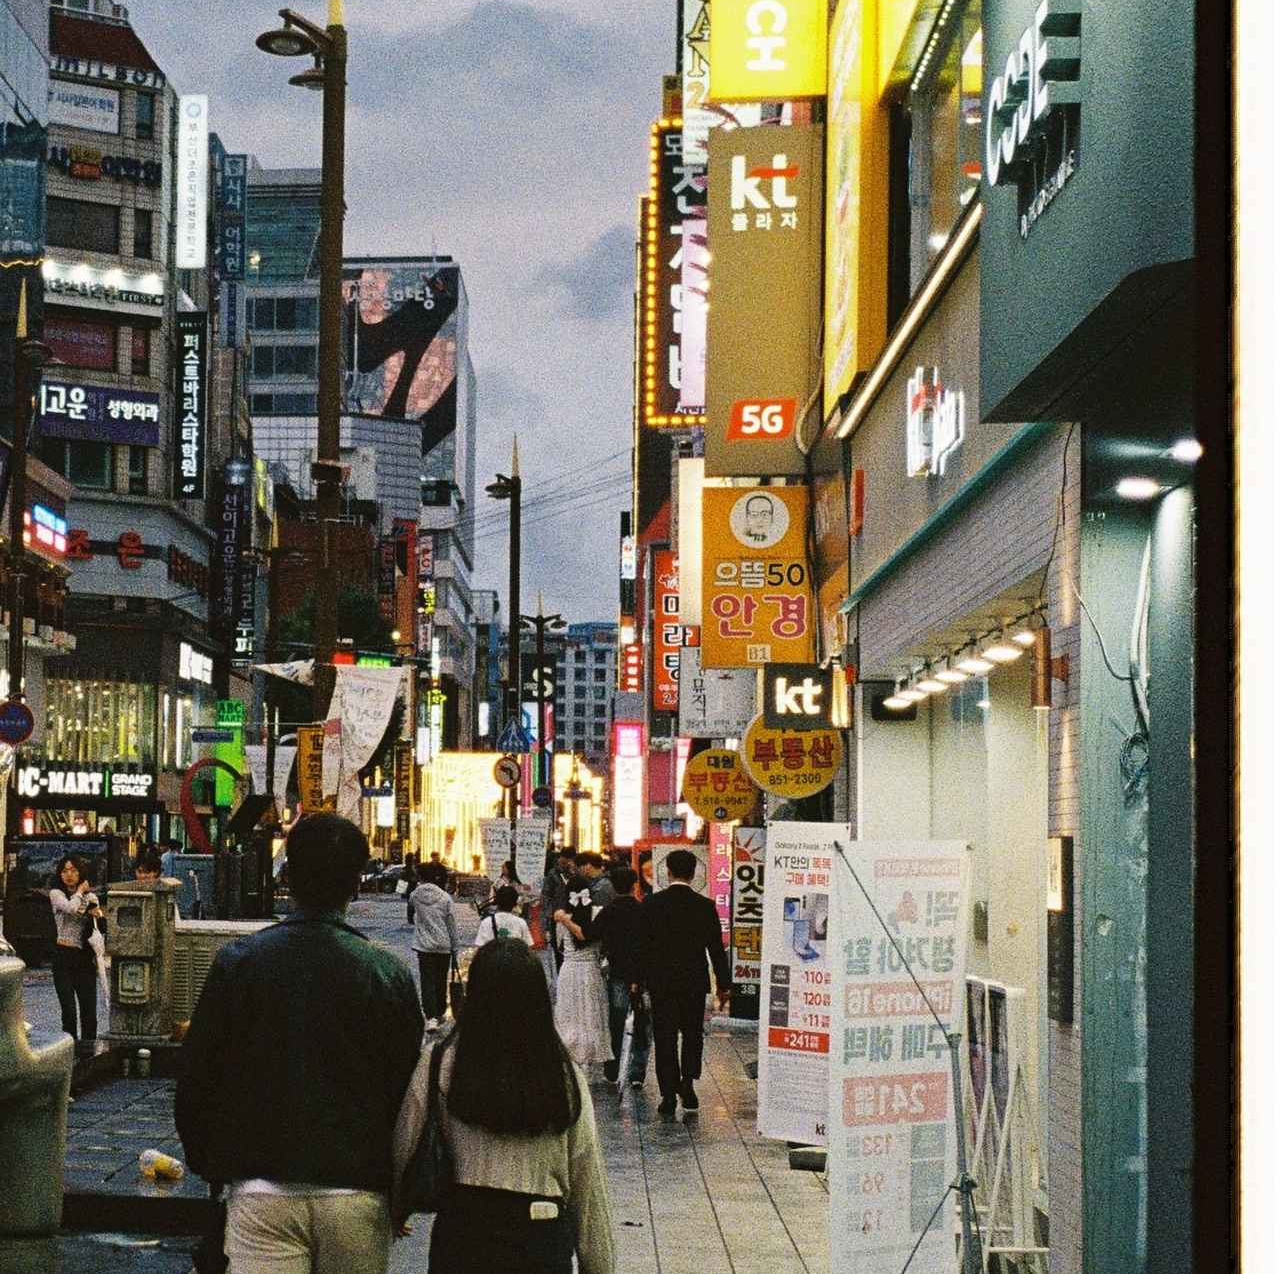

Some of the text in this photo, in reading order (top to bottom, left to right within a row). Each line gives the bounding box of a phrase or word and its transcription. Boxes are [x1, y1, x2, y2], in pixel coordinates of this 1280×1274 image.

[731, 154, 799, 210] kt
[731, 212, 798, 232] 플라자
[106, 398, 159, 423] 성형외과
[181, 333, 199, 478] 퍼스트바리스타학원
[740, 404, 784, 435] 5G
[182, 484, 195, 494] 4F
[714, 560, 803, 589] 으뜸50
[711, 593, 808, 639] 안경
[748, 644, 769, 662] B1
[775, 676, 823, 715] kt
[217, 703, 242, 714] ABC
[752, 739, 834, 770] 부동산
[111, 773, 152, 786] GRAND
[688, 772, 753, 794] 부동산
[769, 775, 821, 786] 851-2300
[111, 785, 148, 797] STAGE
[774, 855, 810, 871] KT만의
[815, 1123, 826, 1136] kt
